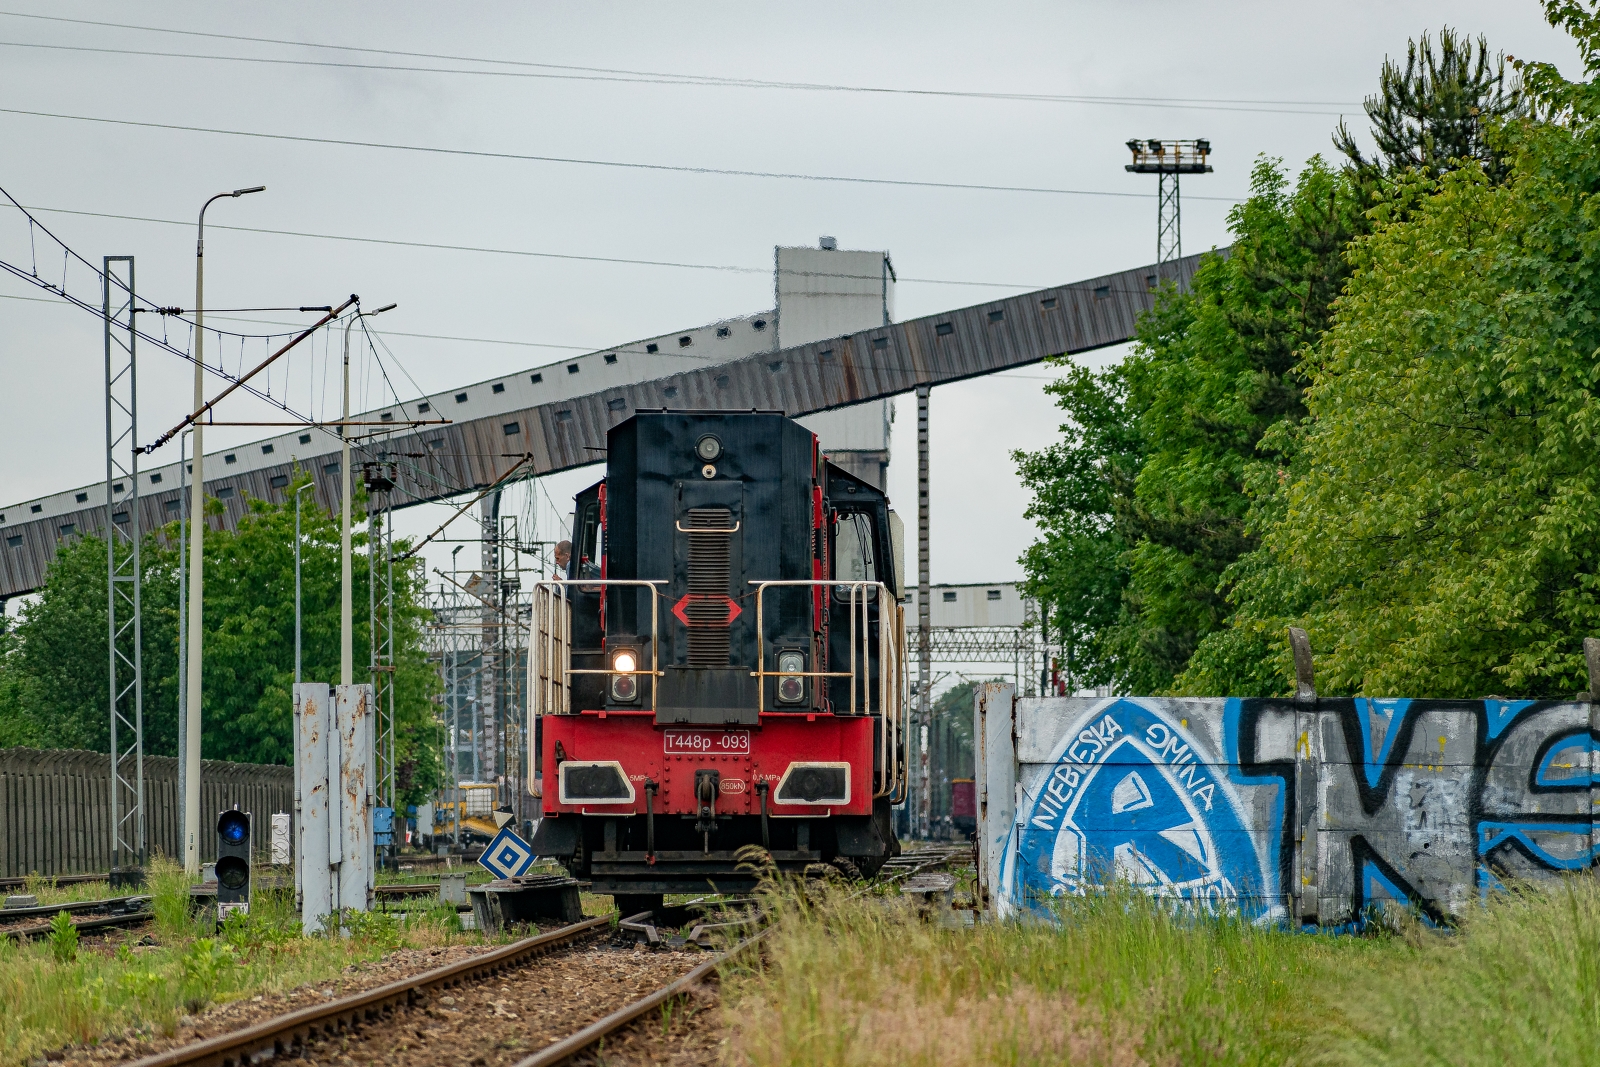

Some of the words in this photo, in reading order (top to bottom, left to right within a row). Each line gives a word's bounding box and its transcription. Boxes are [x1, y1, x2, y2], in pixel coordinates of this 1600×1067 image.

[666, 735, 711, 751] T448p
[716, 735, 748, 749] -093
[1145, 723, 1215, 813] GMINA
[721, 782, 744, 790] 850kN
[1031, 714, 1123, 831] NIEBIESKA
